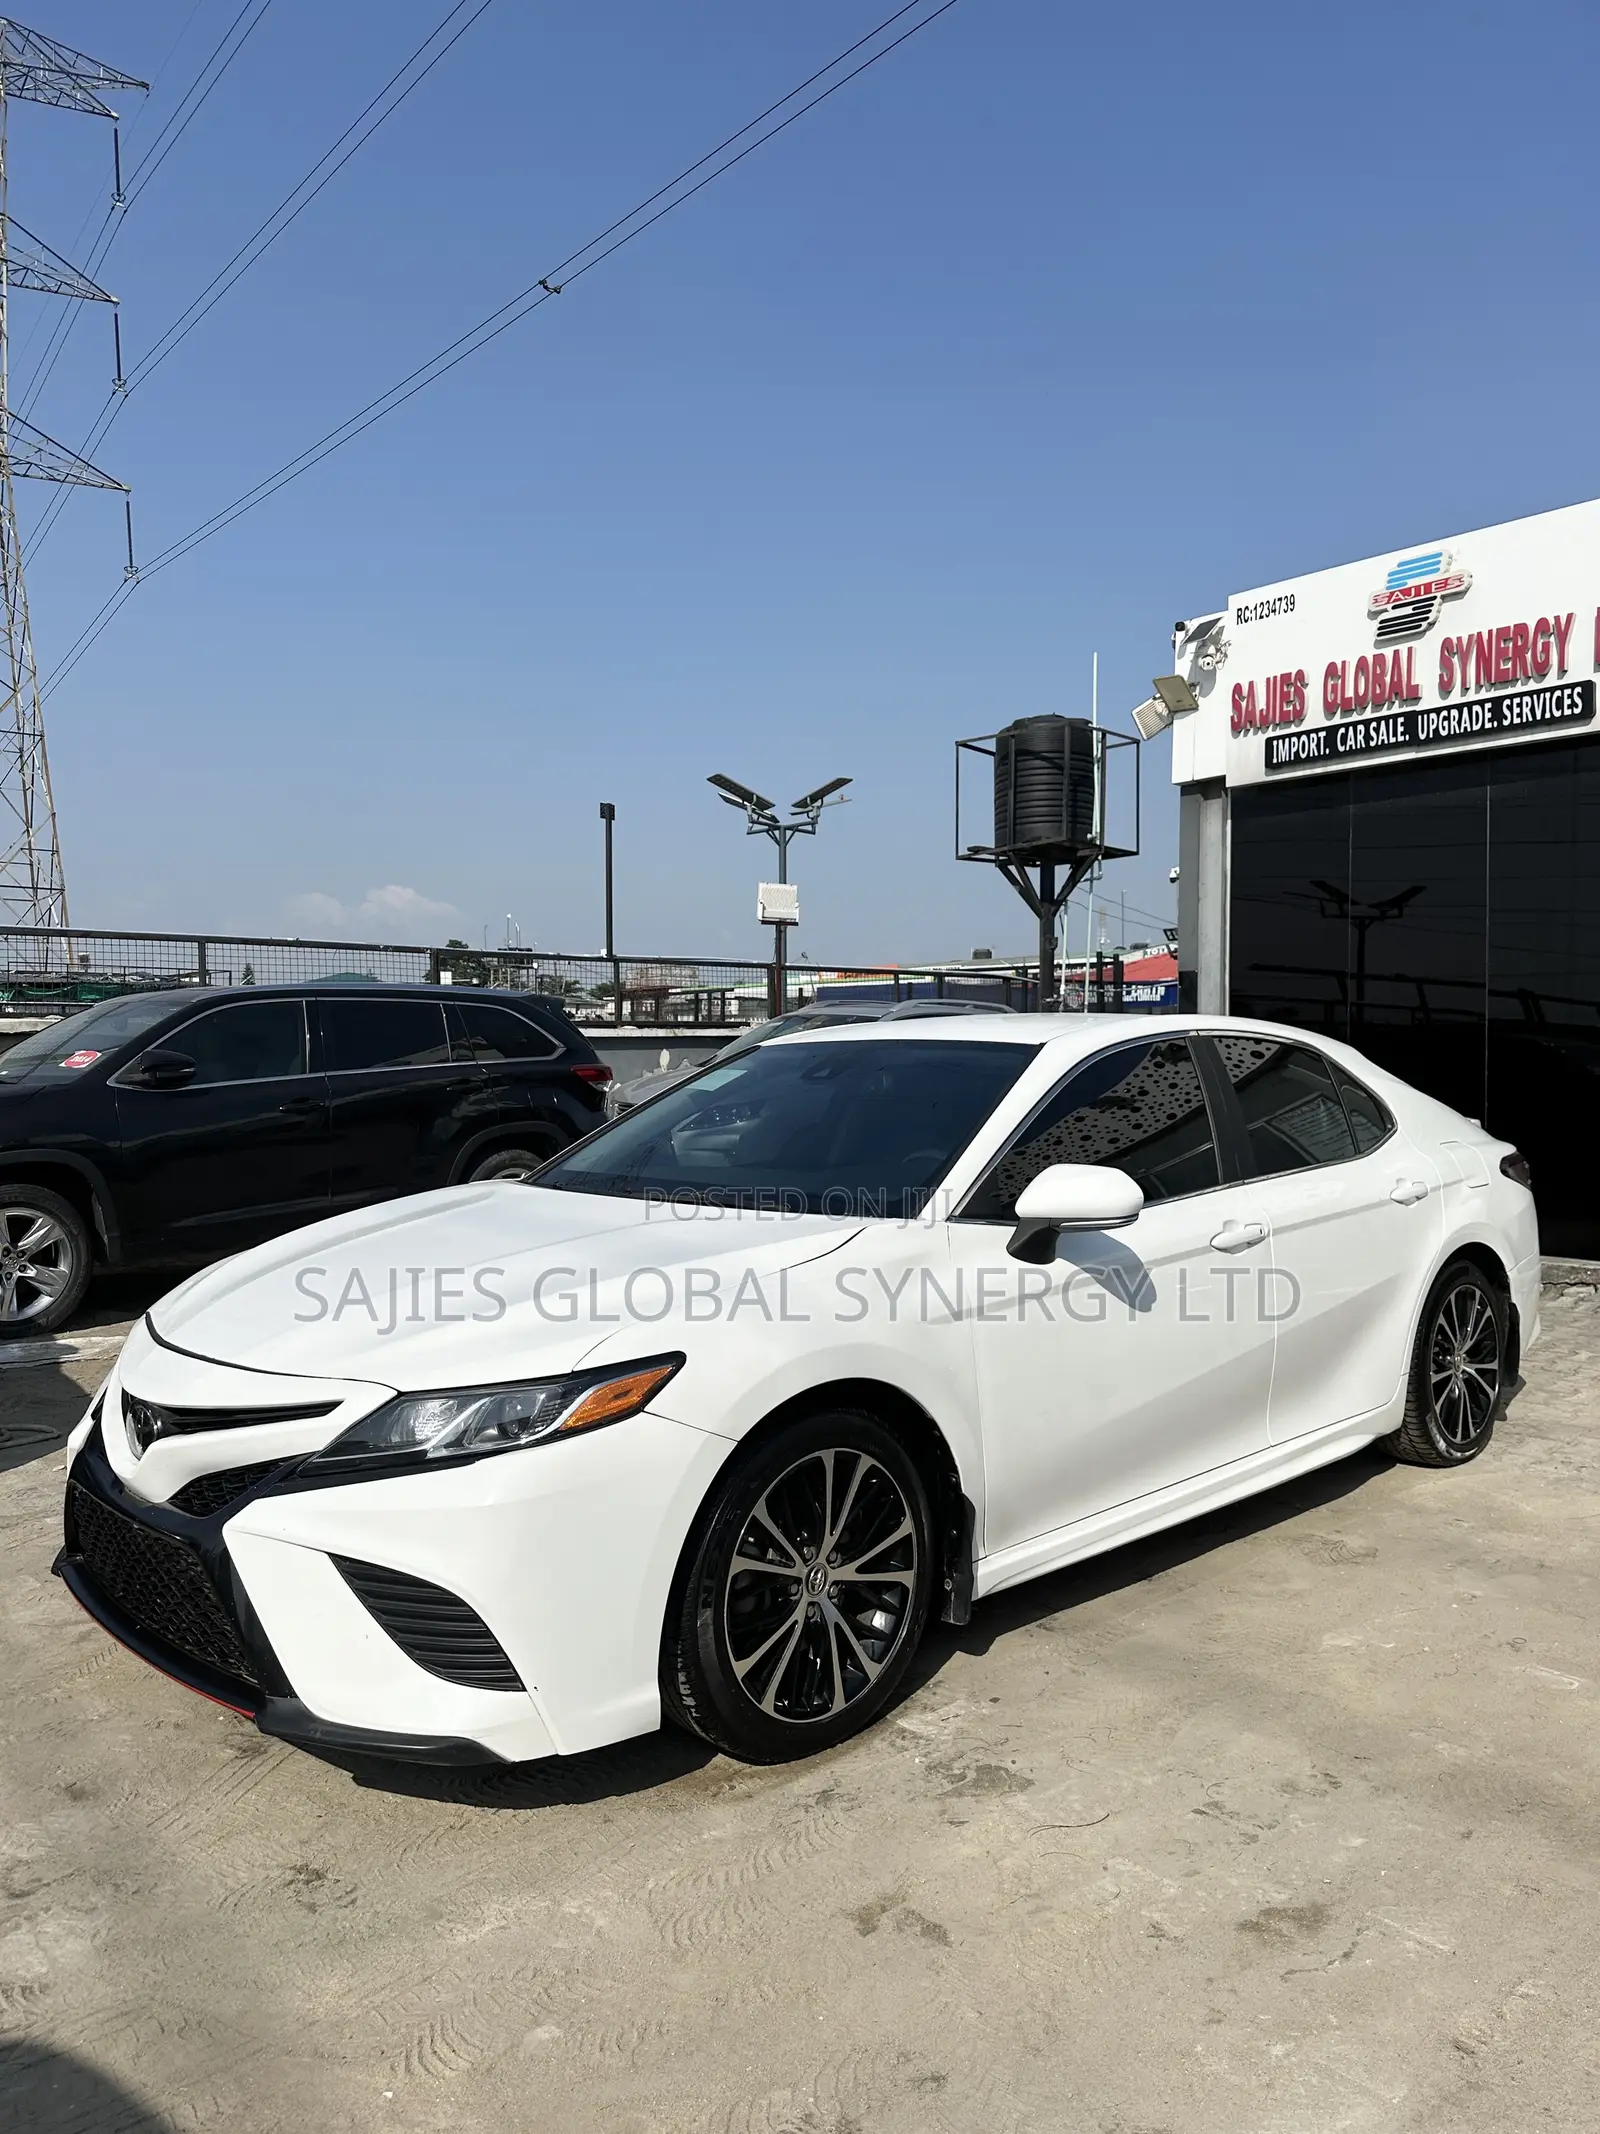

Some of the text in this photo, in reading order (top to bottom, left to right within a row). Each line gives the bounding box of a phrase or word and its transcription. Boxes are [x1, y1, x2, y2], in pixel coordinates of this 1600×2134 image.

[1236, 593, 1296, 626] RC:1234739
[1371, 573, 1465, 608] SAJIES
[1230, 668, 1309, 734] SAJIES
[1322, 646, 1422, 714] GLOBAL
[1438, 612, 1576, 694] SYNERGY
[1272, 686, 1584, 764] IMPORT. CAR SALE. UPGRADE. SERVICES
